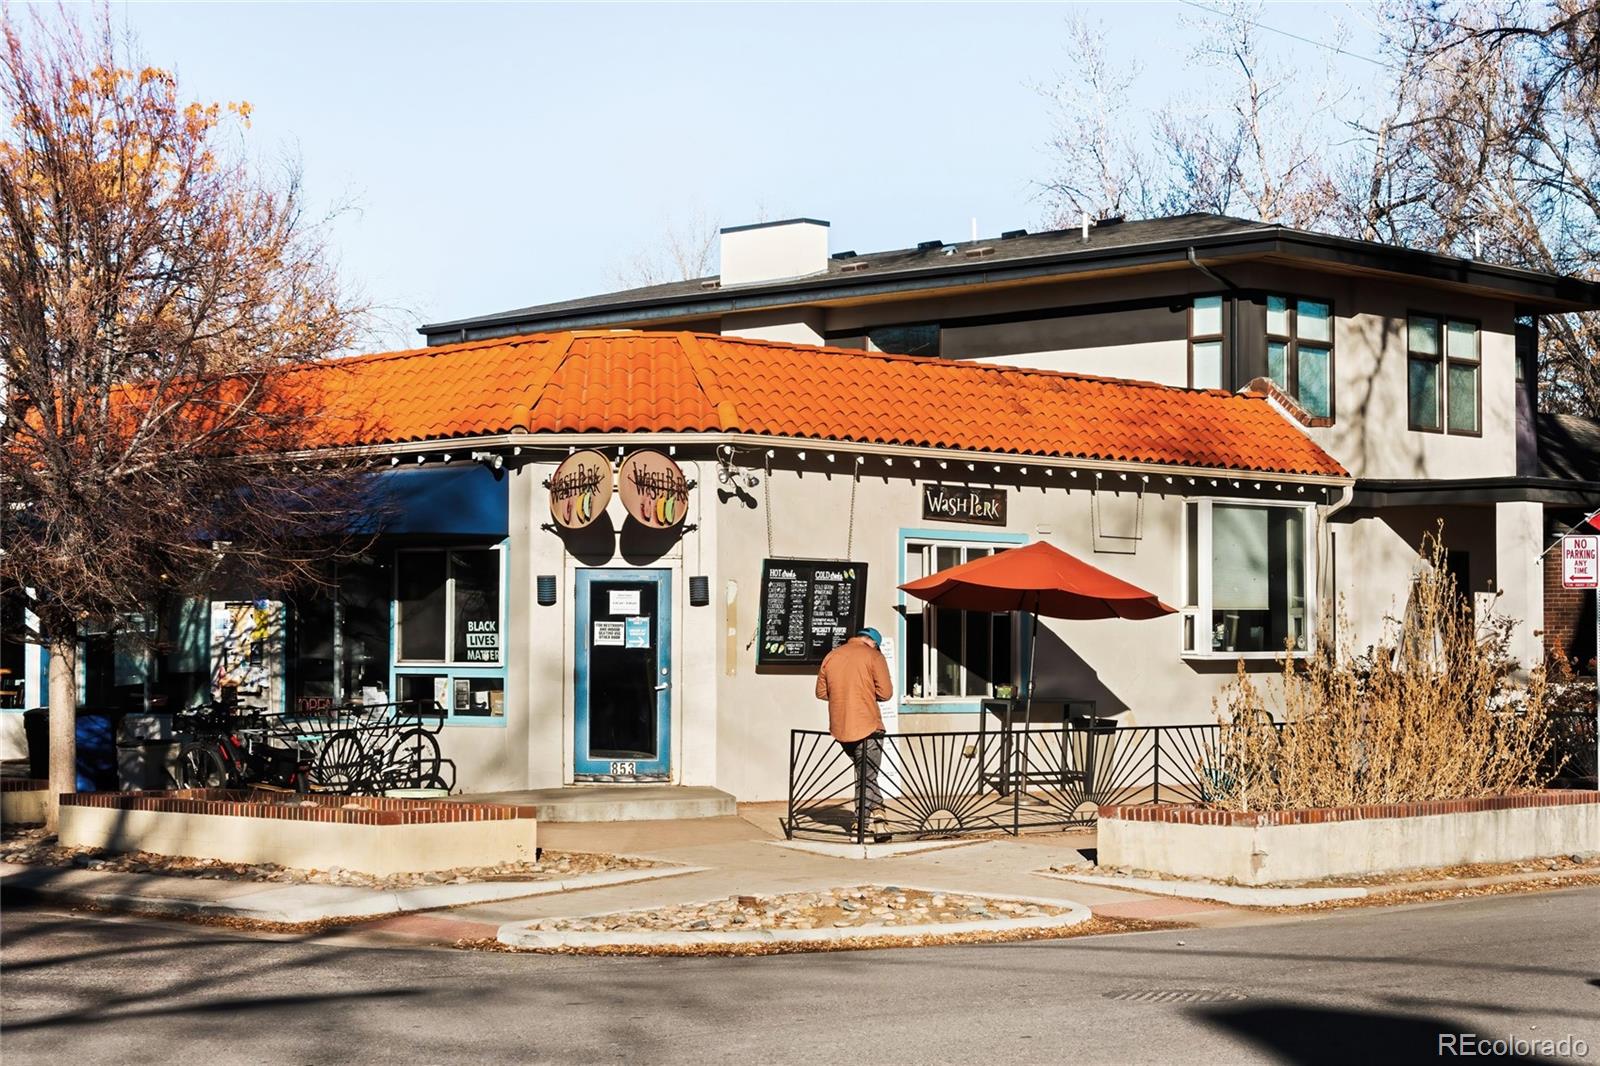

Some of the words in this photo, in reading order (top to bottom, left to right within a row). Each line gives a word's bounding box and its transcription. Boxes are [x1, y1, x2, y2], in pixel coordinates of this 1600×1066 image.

[1574, 539, 1587, 549] NO
[1566, 549, 1596, 560] PARKING
[769, 568, 782, 577] HOT
[814, 570, 830, 579] COLD
[467, 620, 496, 632] BLACK
[469, 635, 496, 646] LIVES
[611, 761, 635, 776] 853
